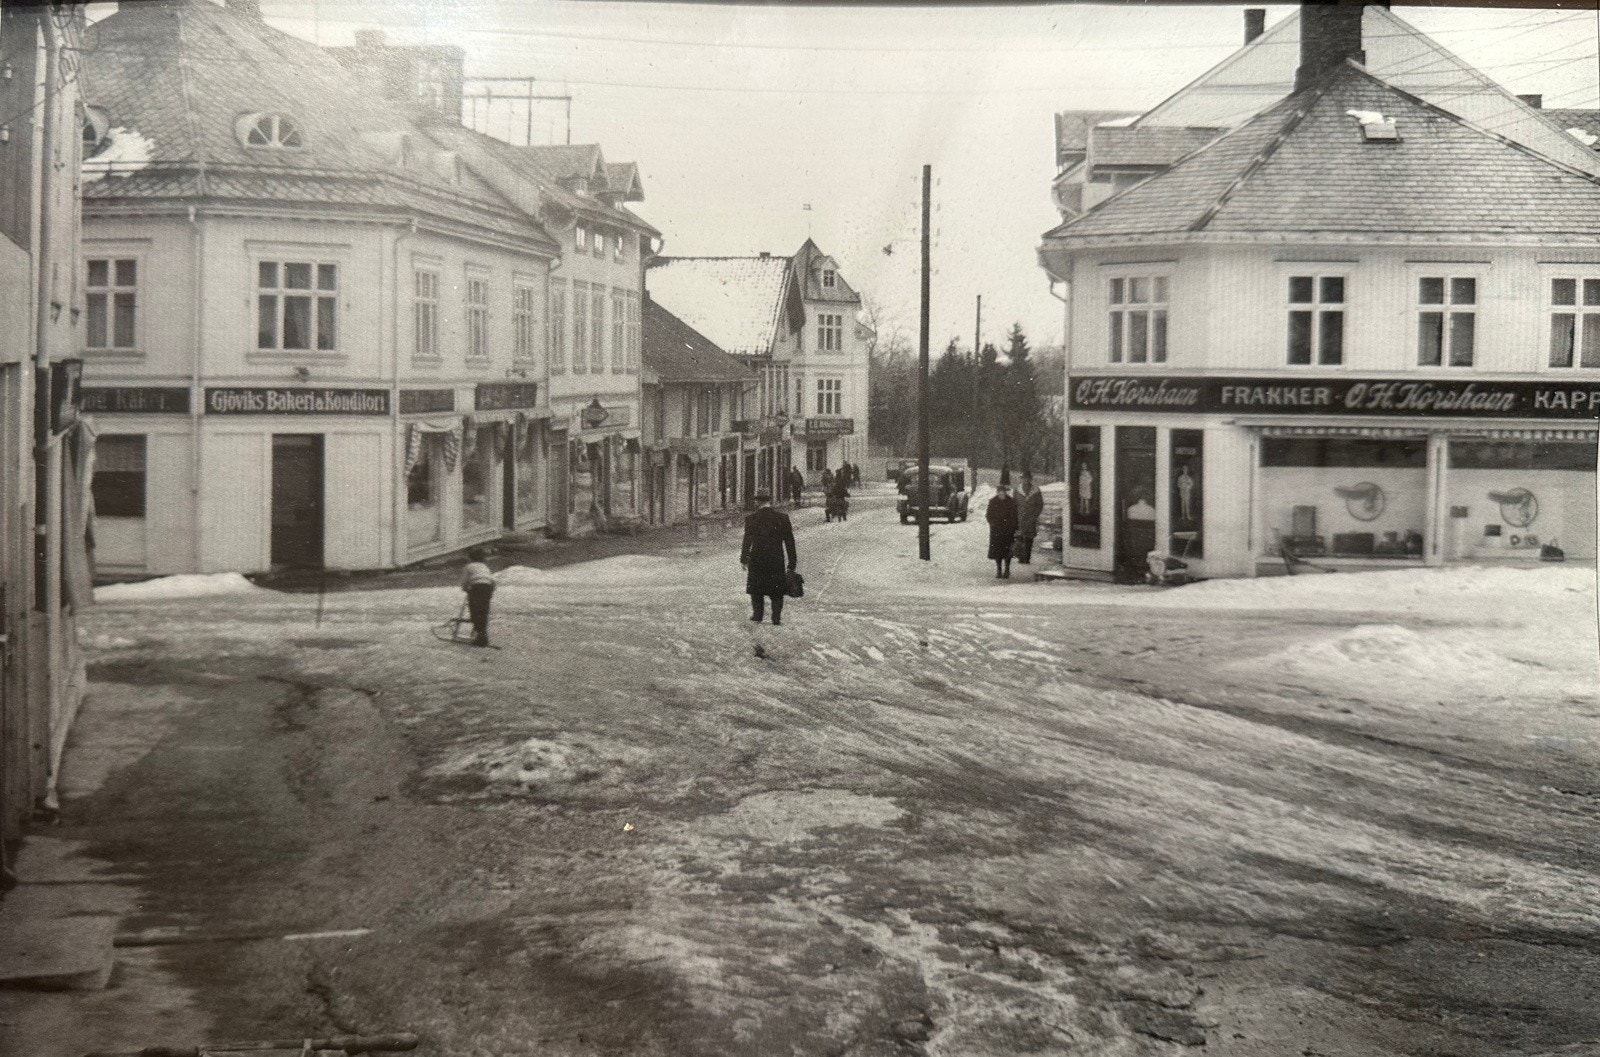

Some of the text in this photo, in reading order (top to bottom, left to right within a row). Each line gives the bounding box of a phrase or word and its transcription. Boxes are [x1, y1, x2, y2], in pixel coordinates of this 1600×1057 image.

[266, 390, 316, 411] Bakeri
[324, 391, 385, 412] Konditori
[1221, 385, 1330, 406] FRAKKER
